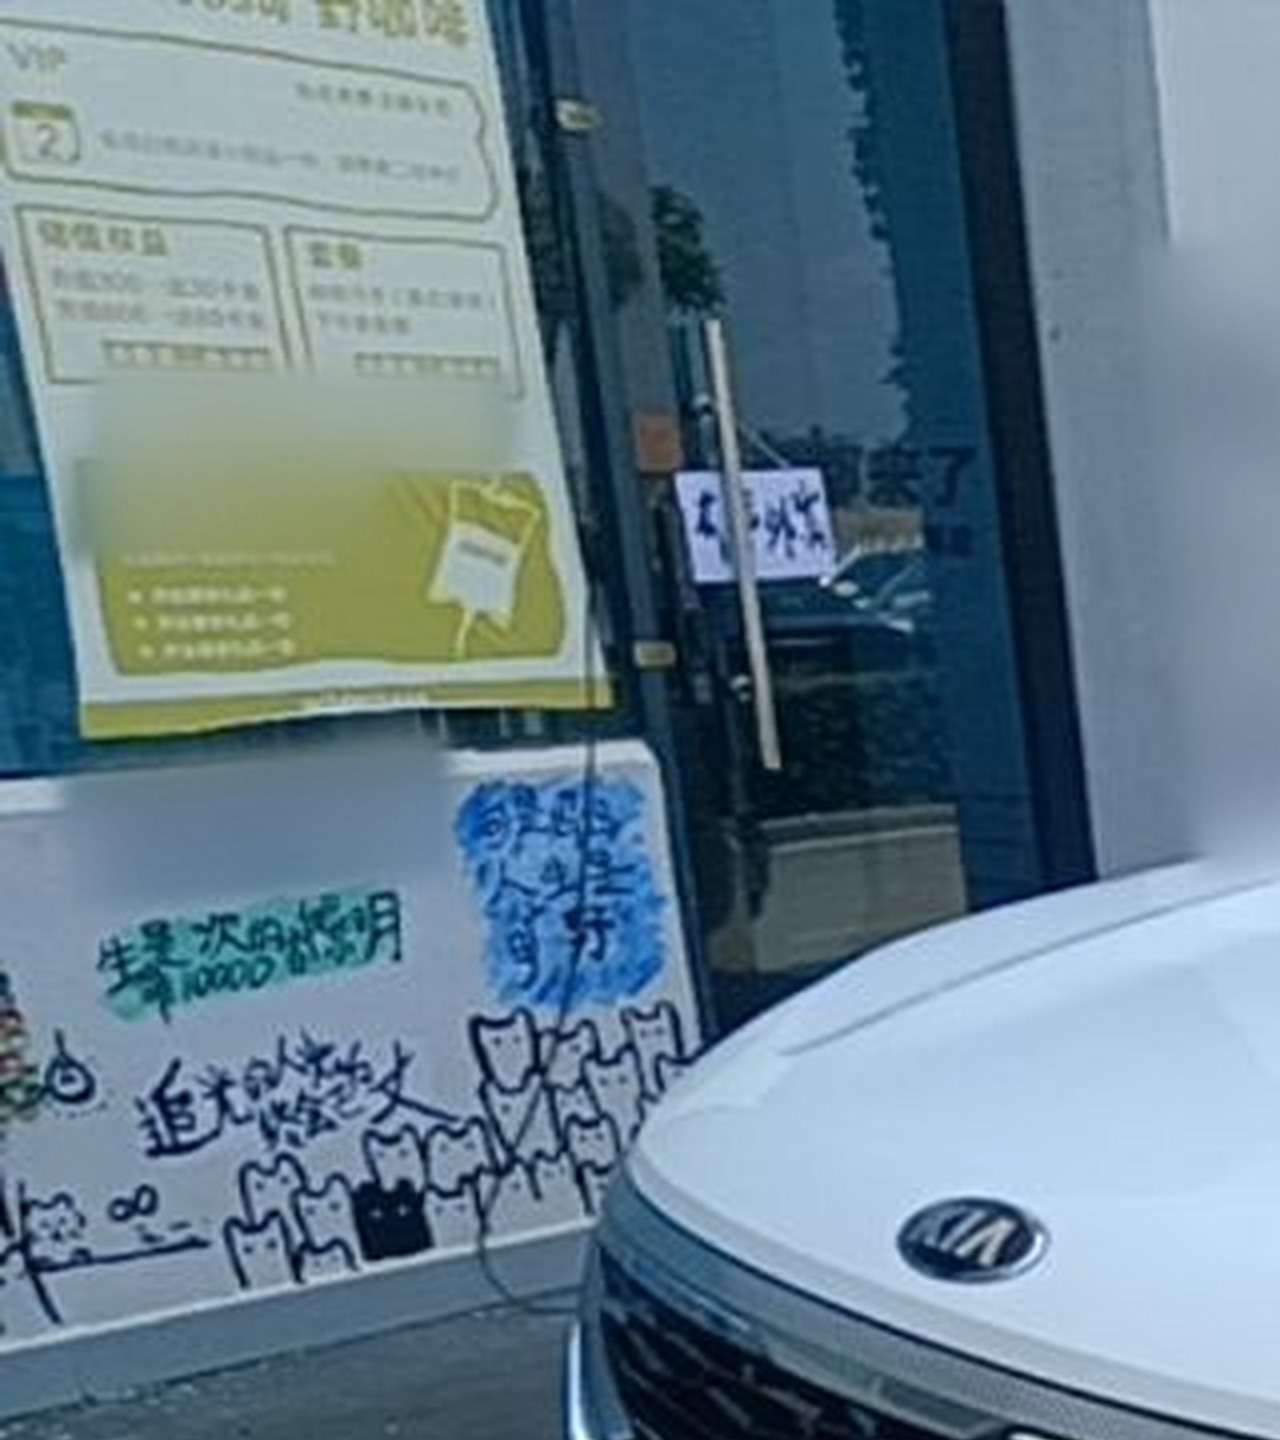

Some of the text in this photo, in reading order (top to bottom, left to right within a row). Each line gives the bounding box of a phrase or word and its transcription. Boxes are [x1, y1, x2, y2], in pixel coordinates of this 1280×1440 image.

[6, 42, 66, 70] VIP
[36, 122, 61, 157] 2
[903, 1203, 1020, 1268] KIA
